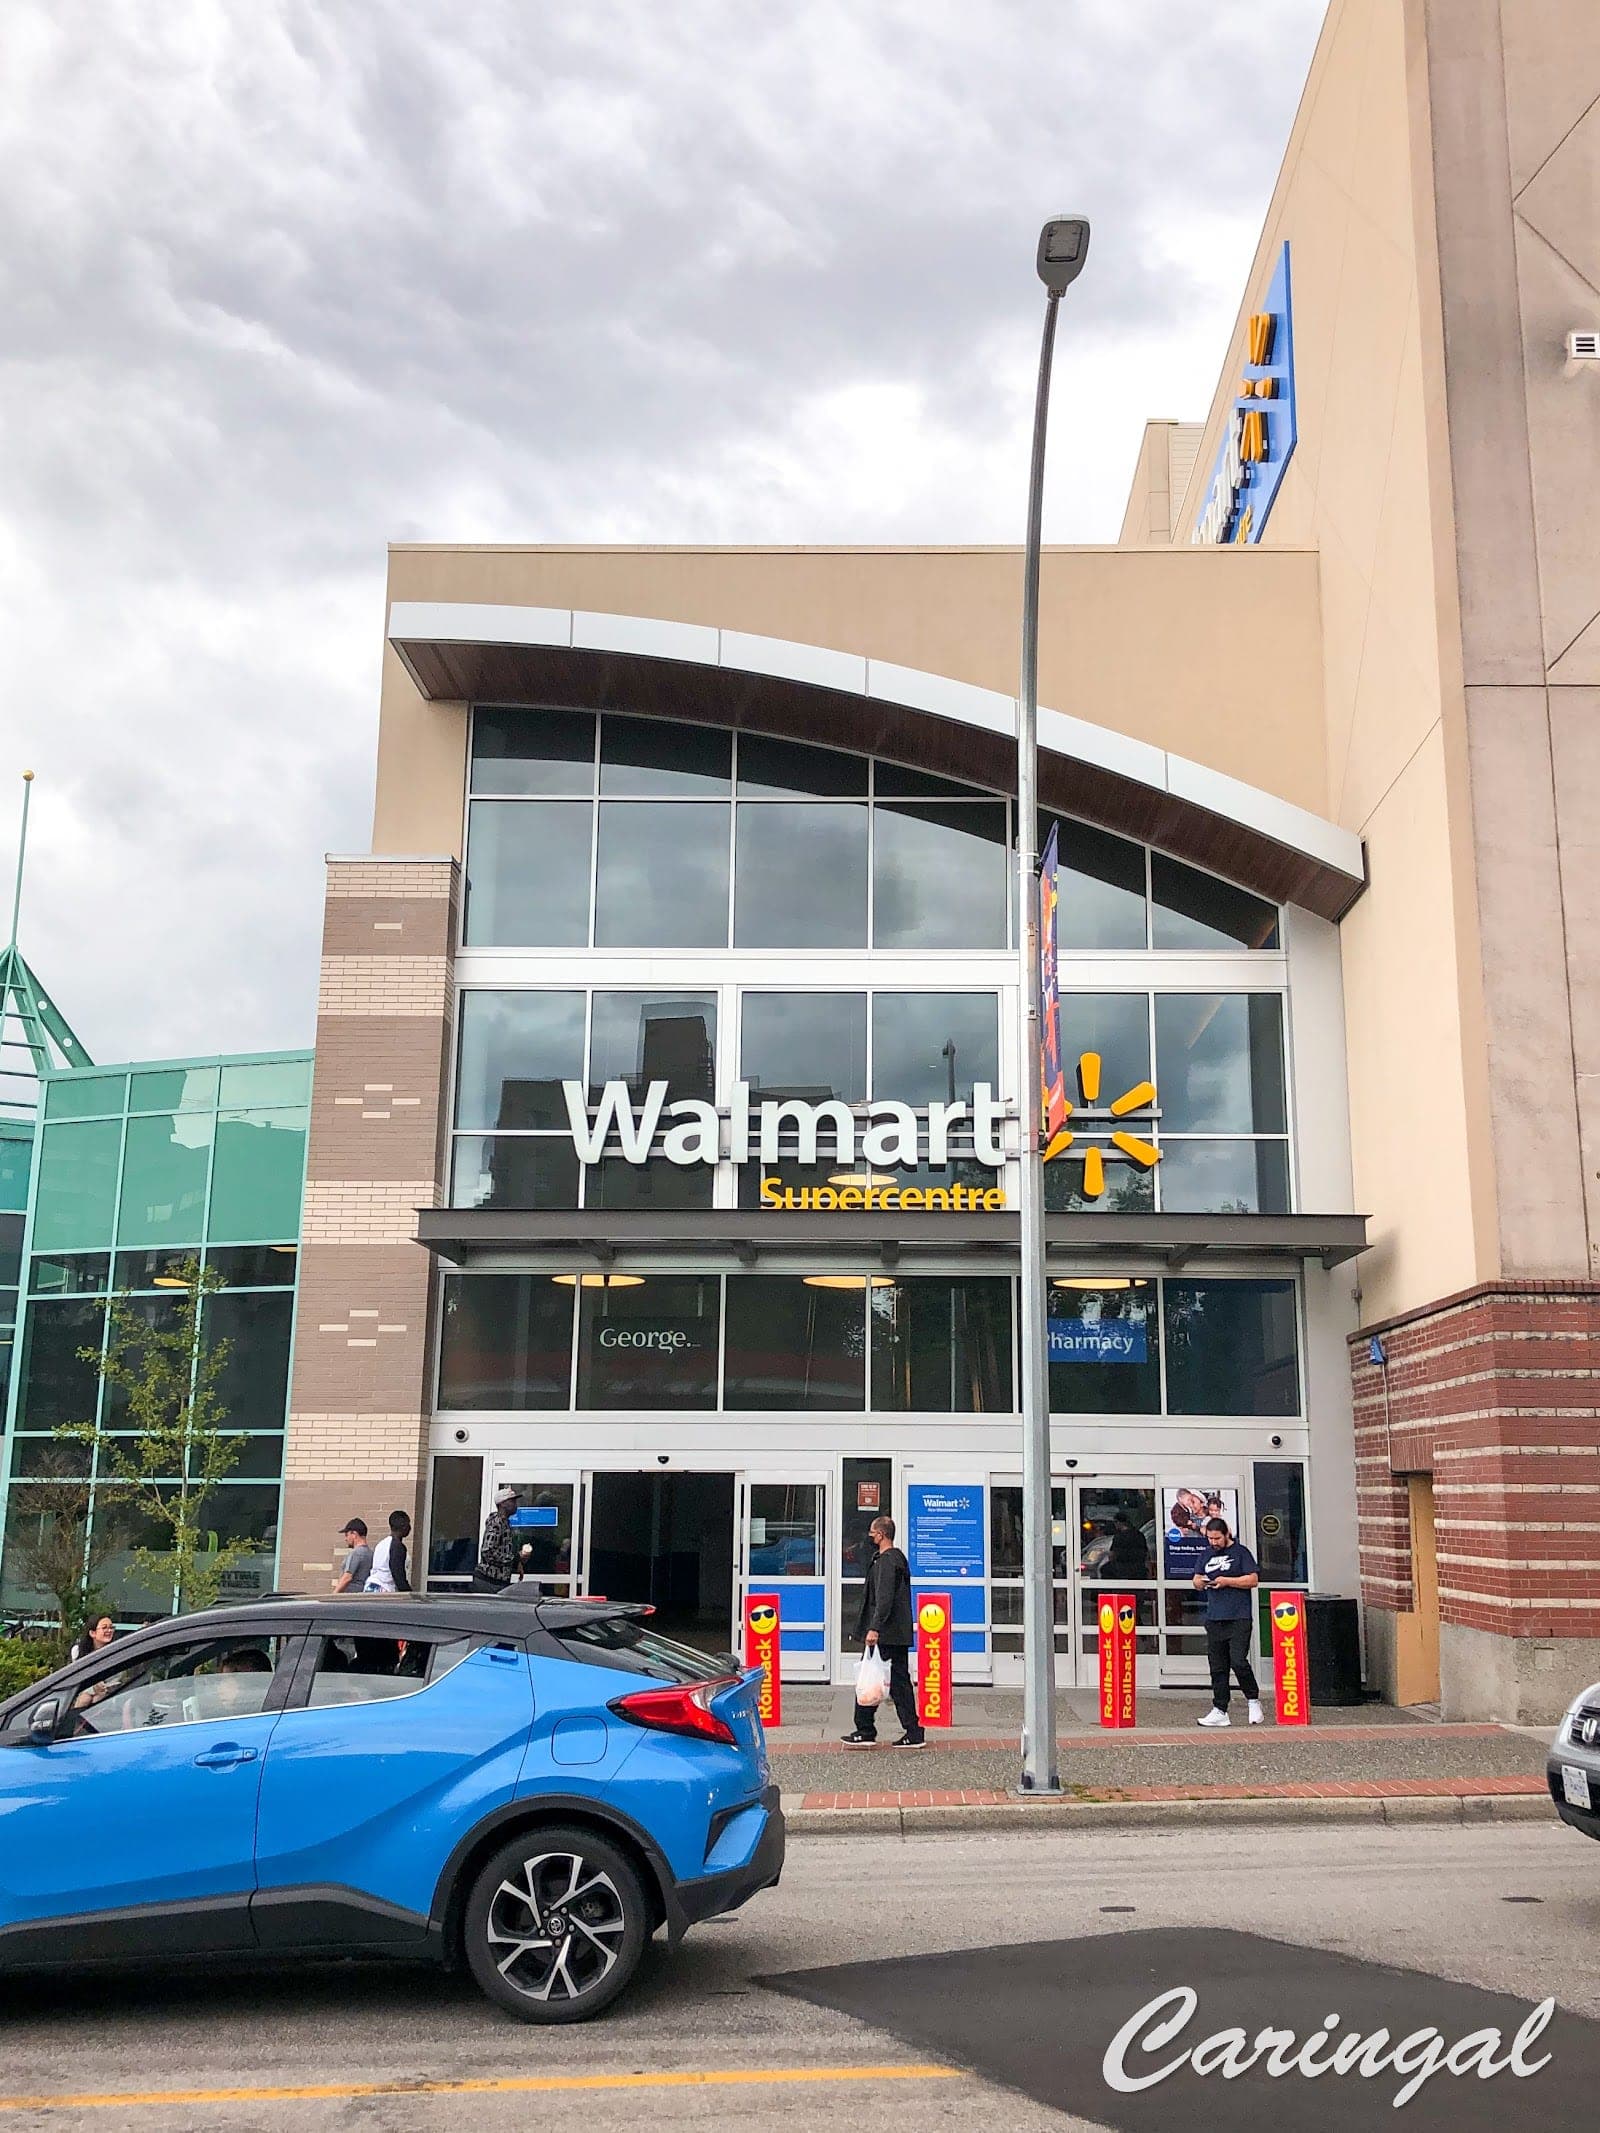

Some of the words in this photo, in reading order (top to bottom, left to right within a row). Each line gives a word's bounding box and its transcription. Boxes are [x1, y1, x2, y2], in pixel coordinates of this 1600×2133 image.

[562, 1080, 1006, 1166] Walmart
[760, 1178, 1007, 1211] Supercentre
[1048, 1331, 1133, 1354] harmacy
[923, 1499, 958, 1507] Walmart
[756, 1638, 773, 1719] Rollback
[925, 1637, 941, 1718] Rollback
[1103, 1638, 1113, 1718] Rollback
[1122, 1639, 1132, 1719] Rollback
[1280, 1635, 1299, 1717] Rollback
